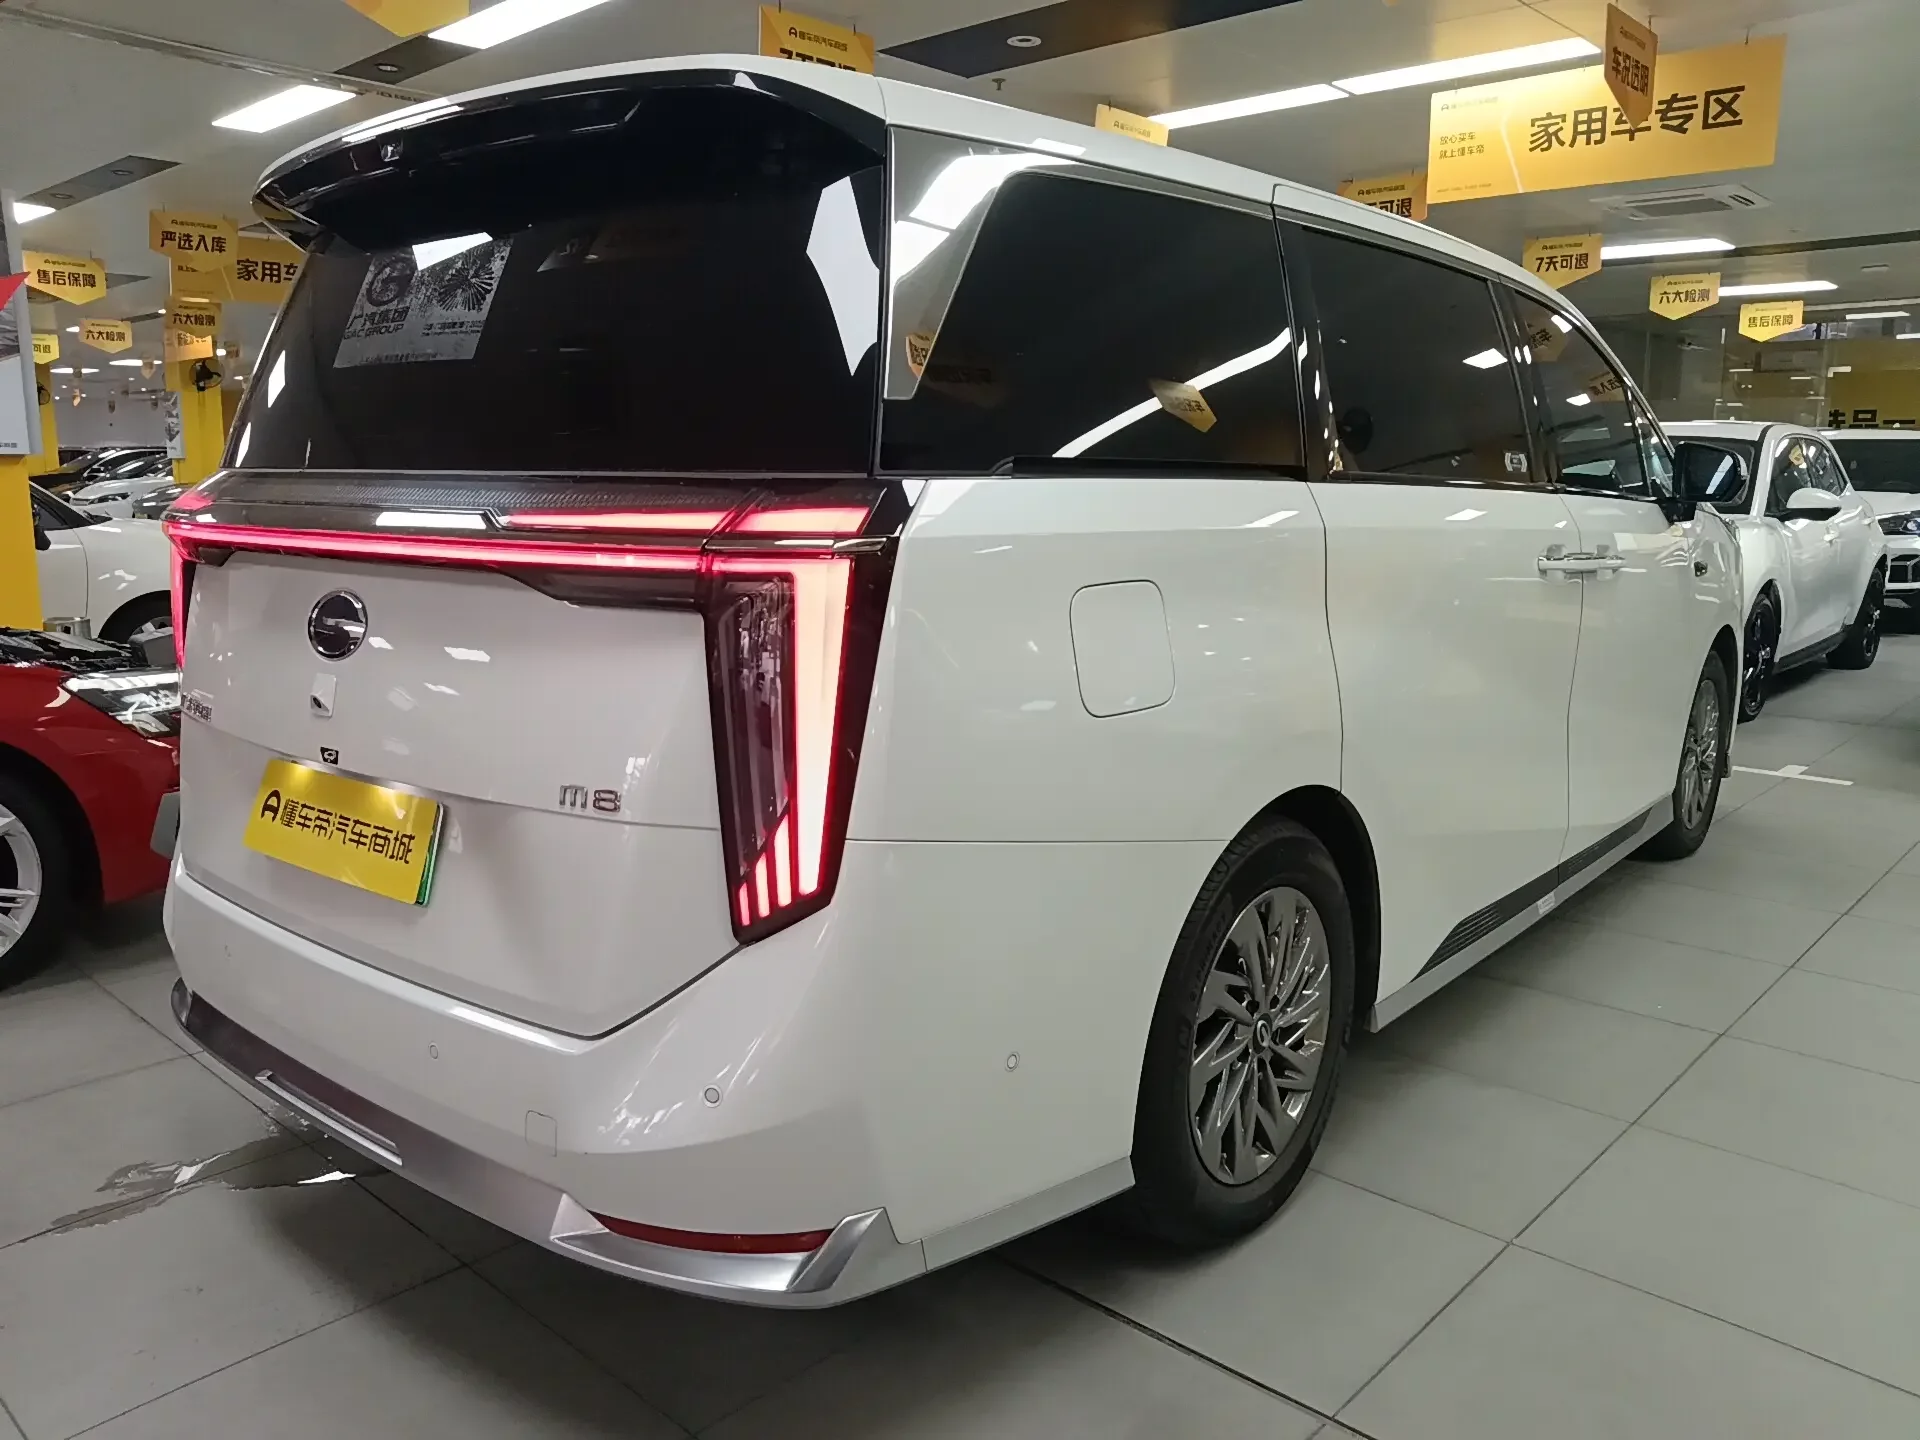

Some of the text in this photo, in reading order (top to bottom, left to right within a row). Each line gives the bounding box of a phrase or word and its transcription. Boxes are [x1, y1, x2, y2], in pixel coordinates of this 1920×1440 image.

[1612, 46, 1650, 97] 车况透明
[1528, 85, 1746, 153] 家用车专区
[160, 230, 227, 254] 严选入库
[1535, 252, 1589, 272] 7天可退
[36, 268, 97, 288] 售后保障
[1659, 287, 1711, 305] 六大检测
[172, 312, 216, 327] 六大检测
[1747, 313, 1794, 328] 售后保障
[84, 329, 126, 343] 六大检测
[280, 797, 416, 865] 懂车帝汽车商城
